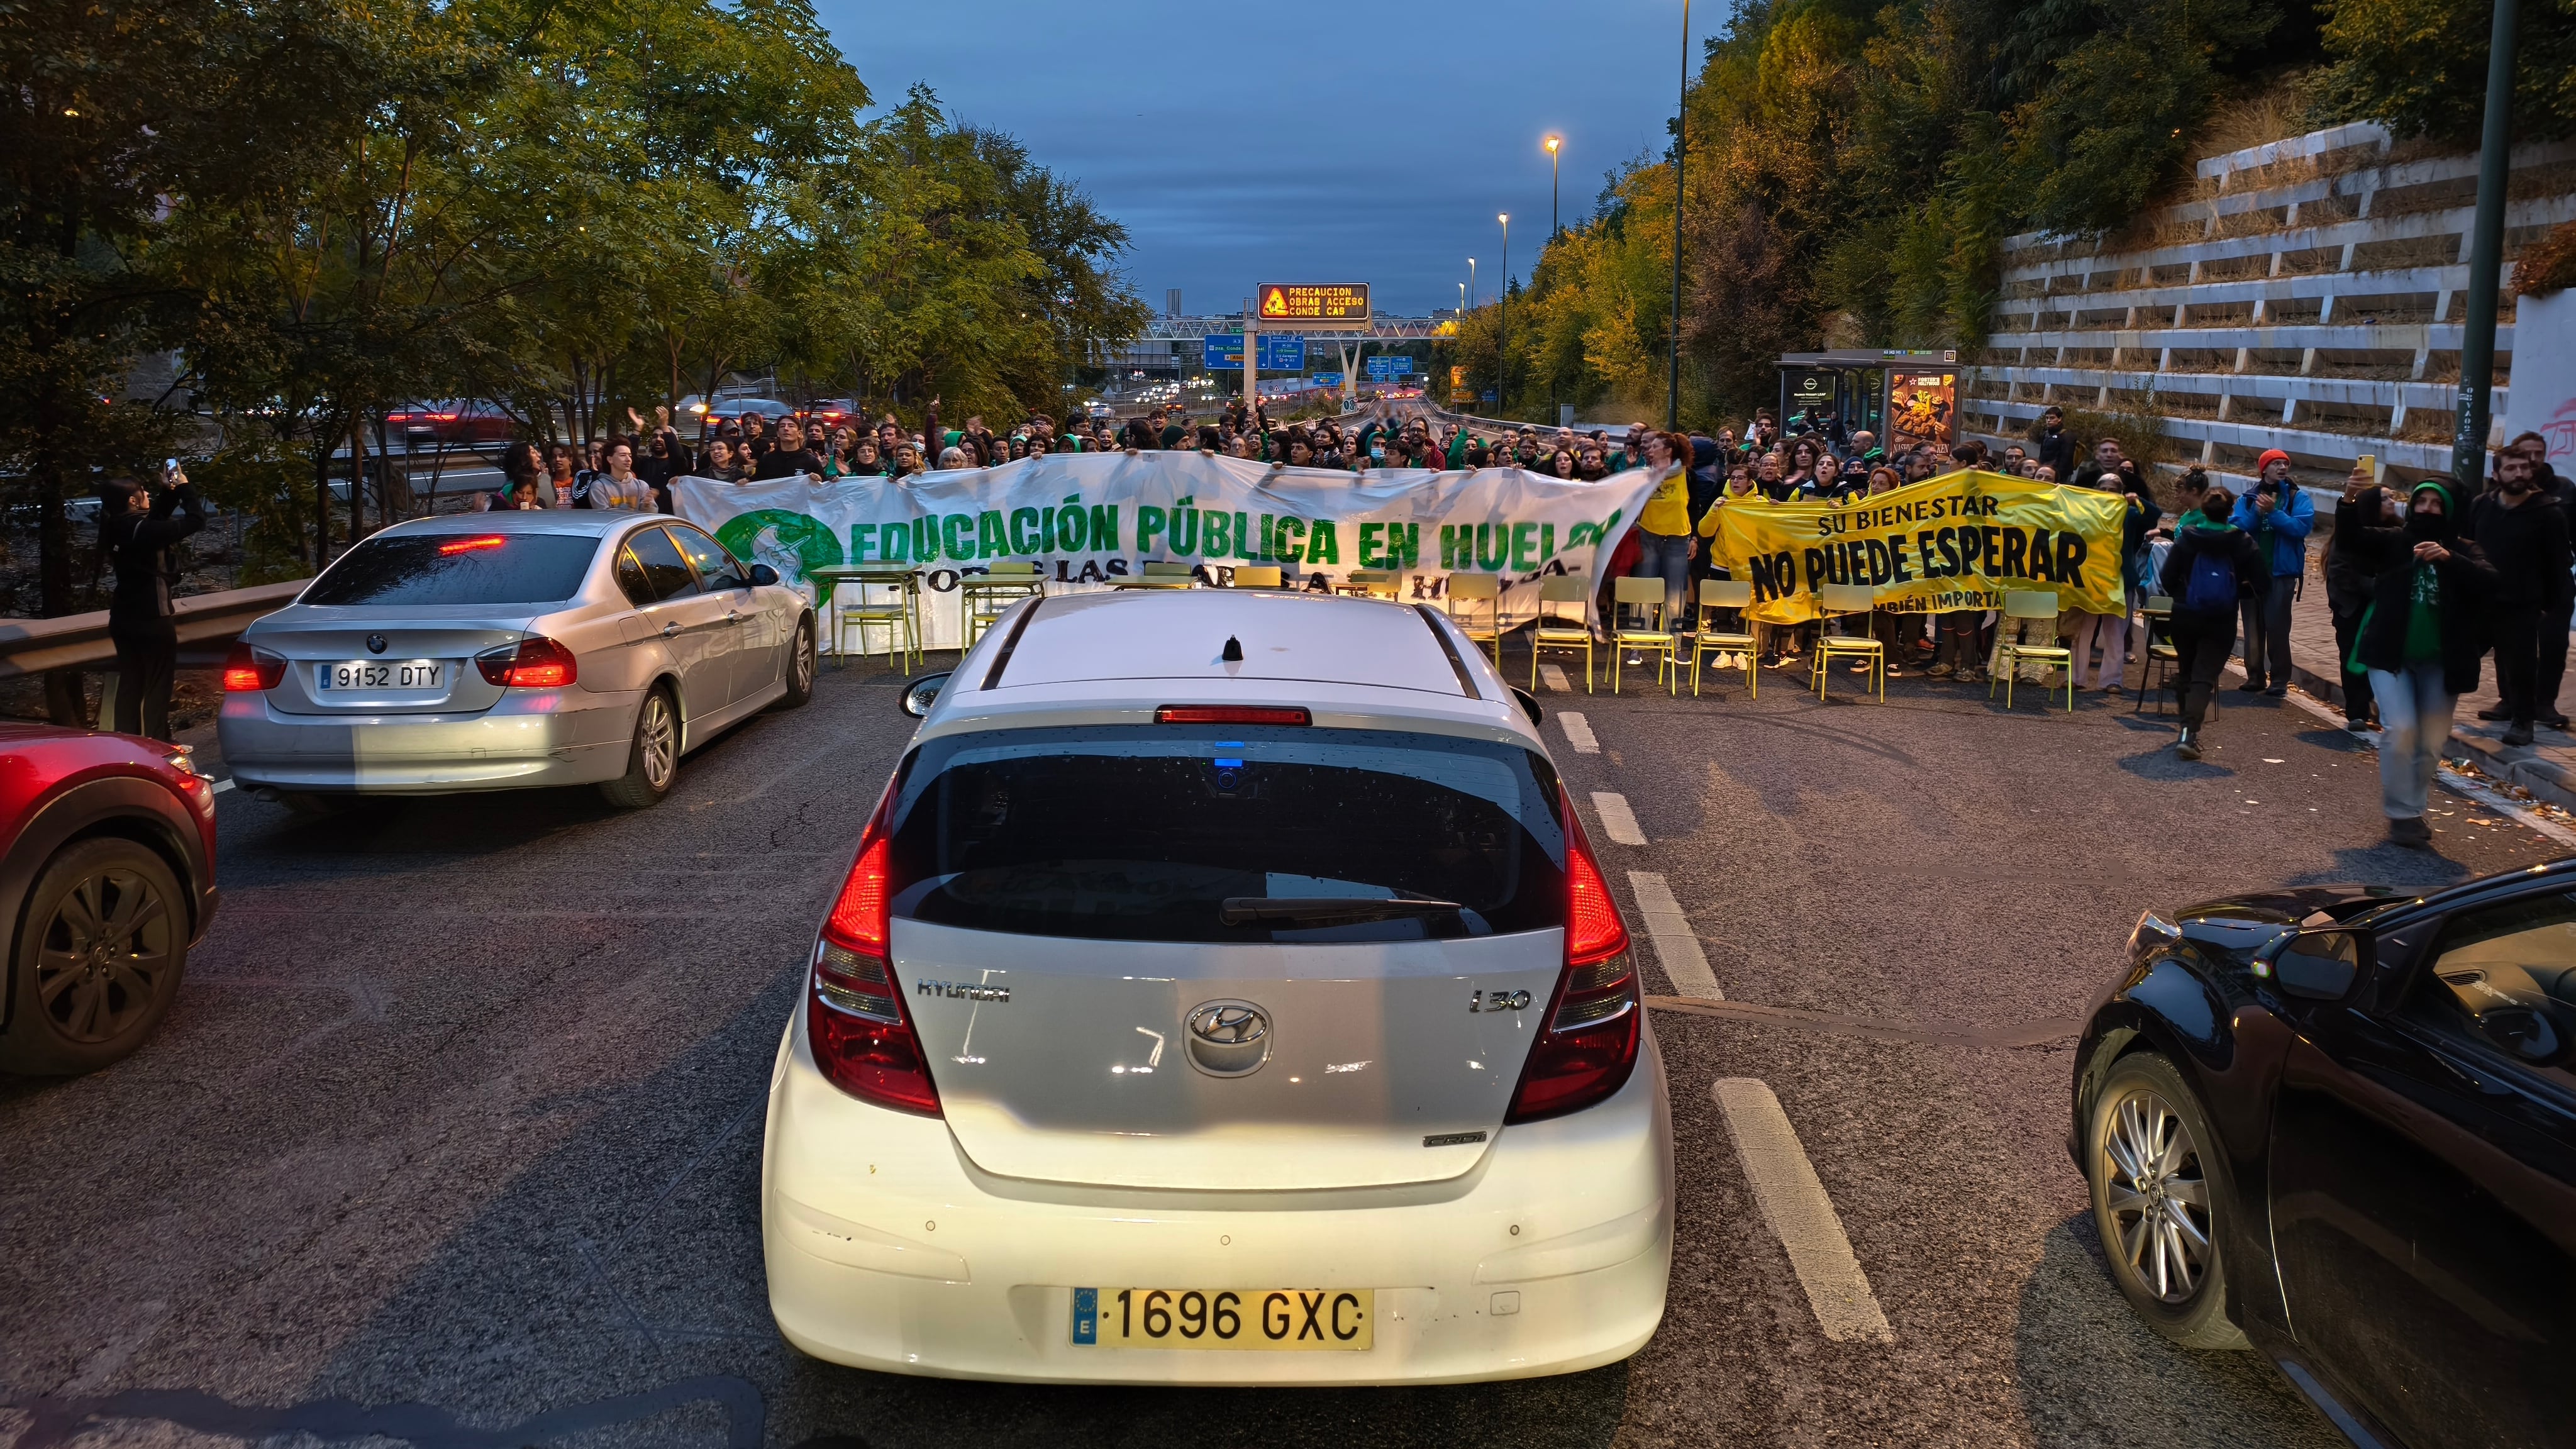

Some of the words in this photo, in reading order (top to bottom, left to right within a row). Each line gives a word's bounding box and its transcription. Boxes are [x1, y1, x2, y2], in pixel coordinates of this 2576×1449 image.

[1289, 287, 1352, 296] PRECAUCION
[1289, 297, 1320, 306] OBRAS
[1326, 297, 1363, 306] ACCESO
[1289, 306, 1320, 316] CONDE
[1326, 306, 1345, 316] CAS
[1818, 513, 1846, 537] SU
[1857, 495, 1999, 531] BIENESTAR
[851, 493, 1119, 565] EDUCACIÓN
[1136, 495, 1339, 565] PÚBLICA
[1359, 522, 1419, 570] EN
[1748, 550, 1797, 604] NO
[1805, 535, 1913, 594] PUEDE
[1916, 526, 2087, 589] ESPERAR
[1872, 594, 1927, 613] MBIÉN
[1931, 591, 2002, 610] IMPORTA
[338, 667, 389, 687] 9152
[401, 666, 440, 686] DTY
[917, 978, 1010, 1002] HYUNDAI
[1117, 1289, 1241, 1340] 1696
[1262, 1292, 1358, 1341] GXC
[1080, 1321, 1090, 1334] E
